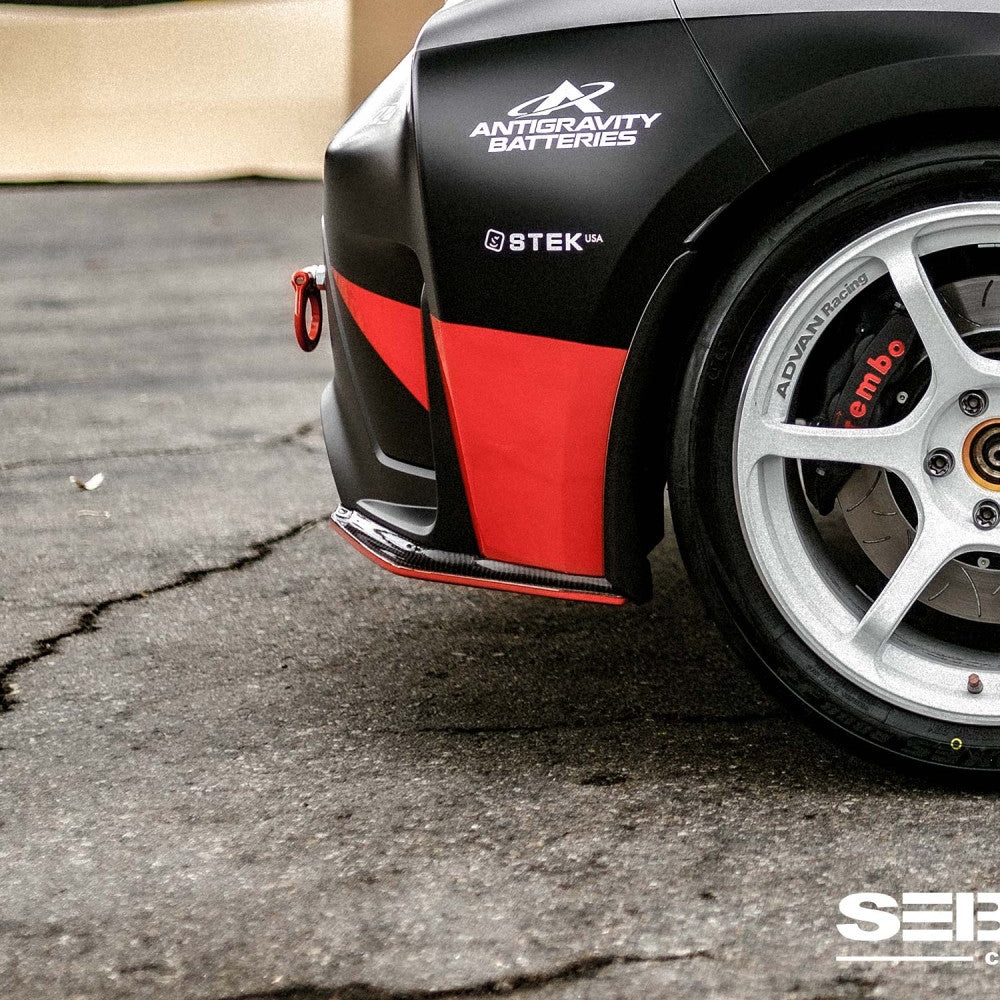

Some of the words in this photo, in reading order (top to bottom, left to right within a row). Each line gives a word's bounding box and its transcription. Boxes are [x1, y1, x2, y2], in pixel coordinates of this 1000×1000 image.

[469, 113, 662, 137] ANTIGRAVITY
[487, 130, 638, 153] BATTERIES
[509, 233, 584, 251] STEK
[585, 234, 604, 243] USA
[776, 315, 825, 399] ADVAN
[821, 272, 869, 317] Racing
[844, 340, 906, 428] embo
